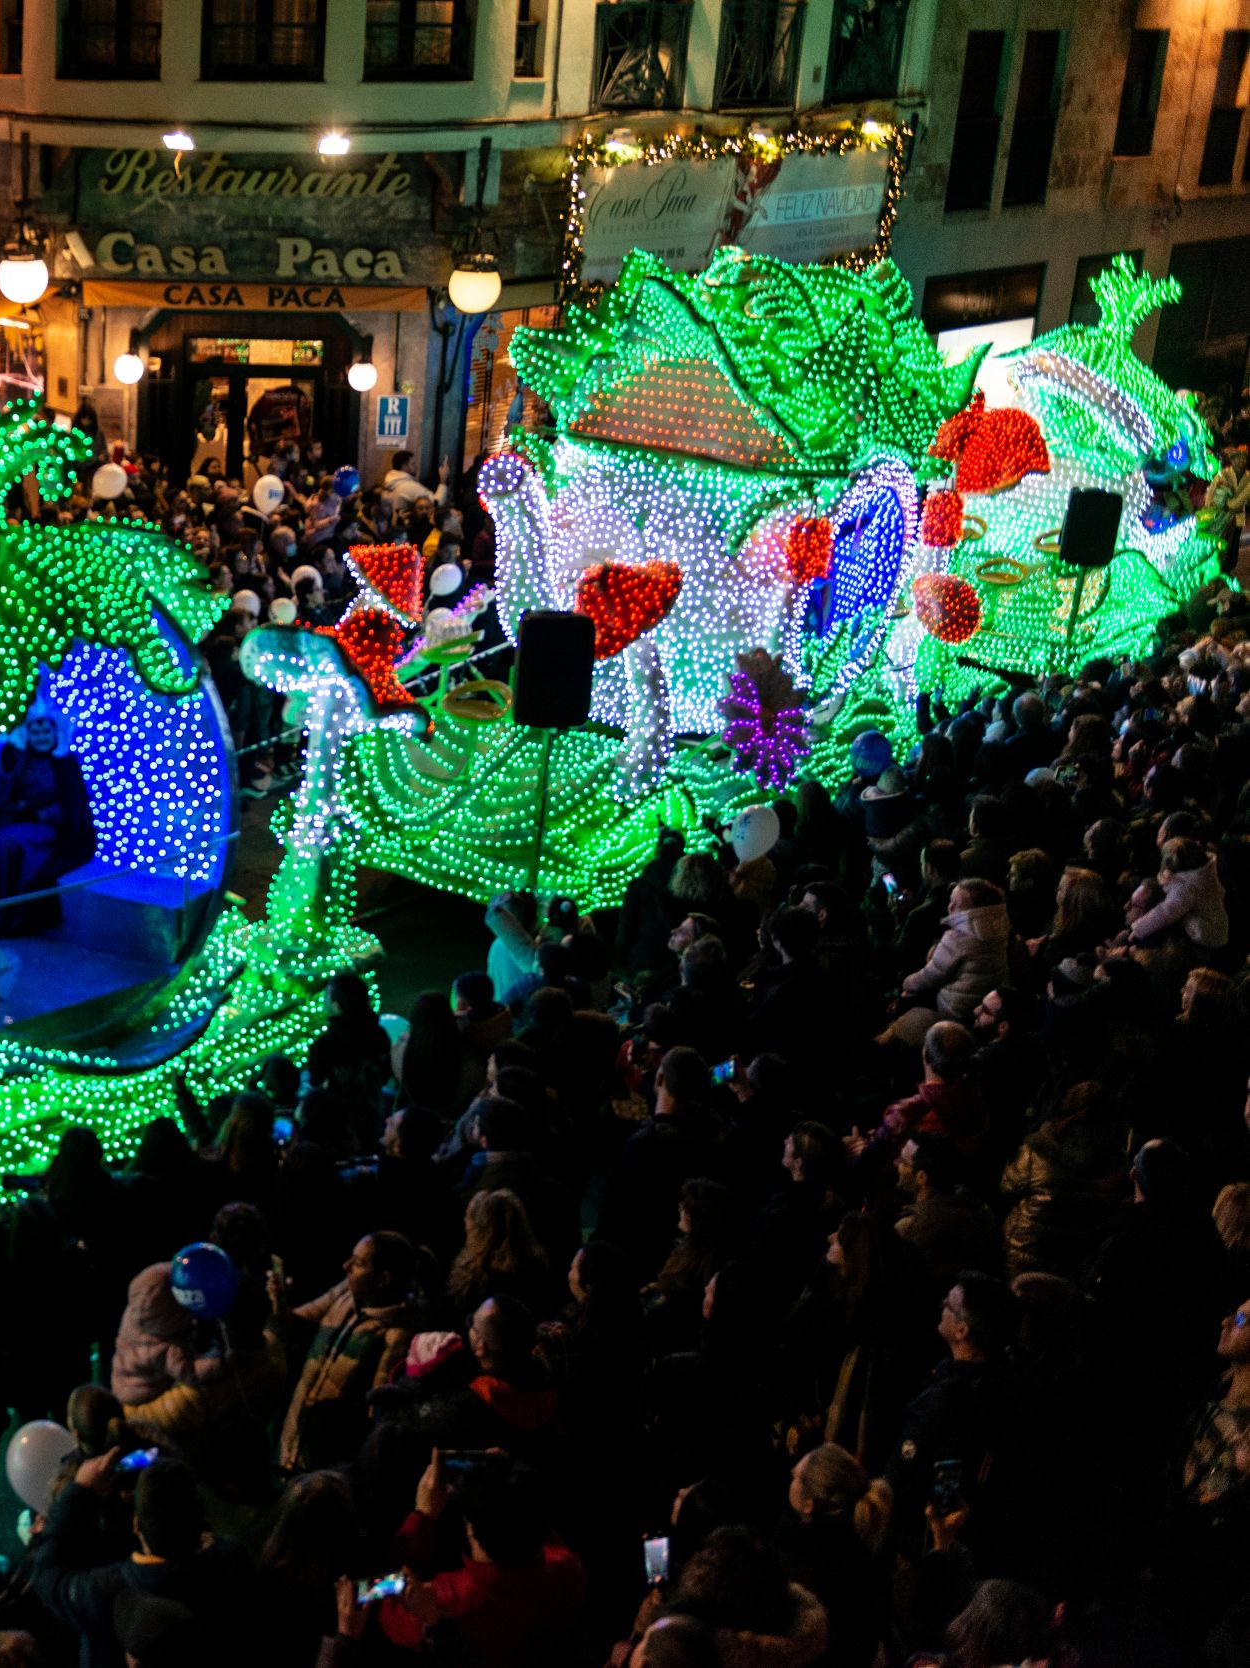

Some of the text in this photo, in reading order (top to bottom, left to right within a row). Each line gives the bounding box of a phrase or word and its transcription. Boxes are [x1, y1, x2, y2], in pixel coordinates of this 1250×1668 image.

[101, 147, 411, 199] Restaurante
[775, 187, 876, 221] FELIZ NAVIDAD
[96, 231, 406, 280] Casa Paca
[163, 285, 346, 307] CASA PACA
[387, 397, 400, 414] R
